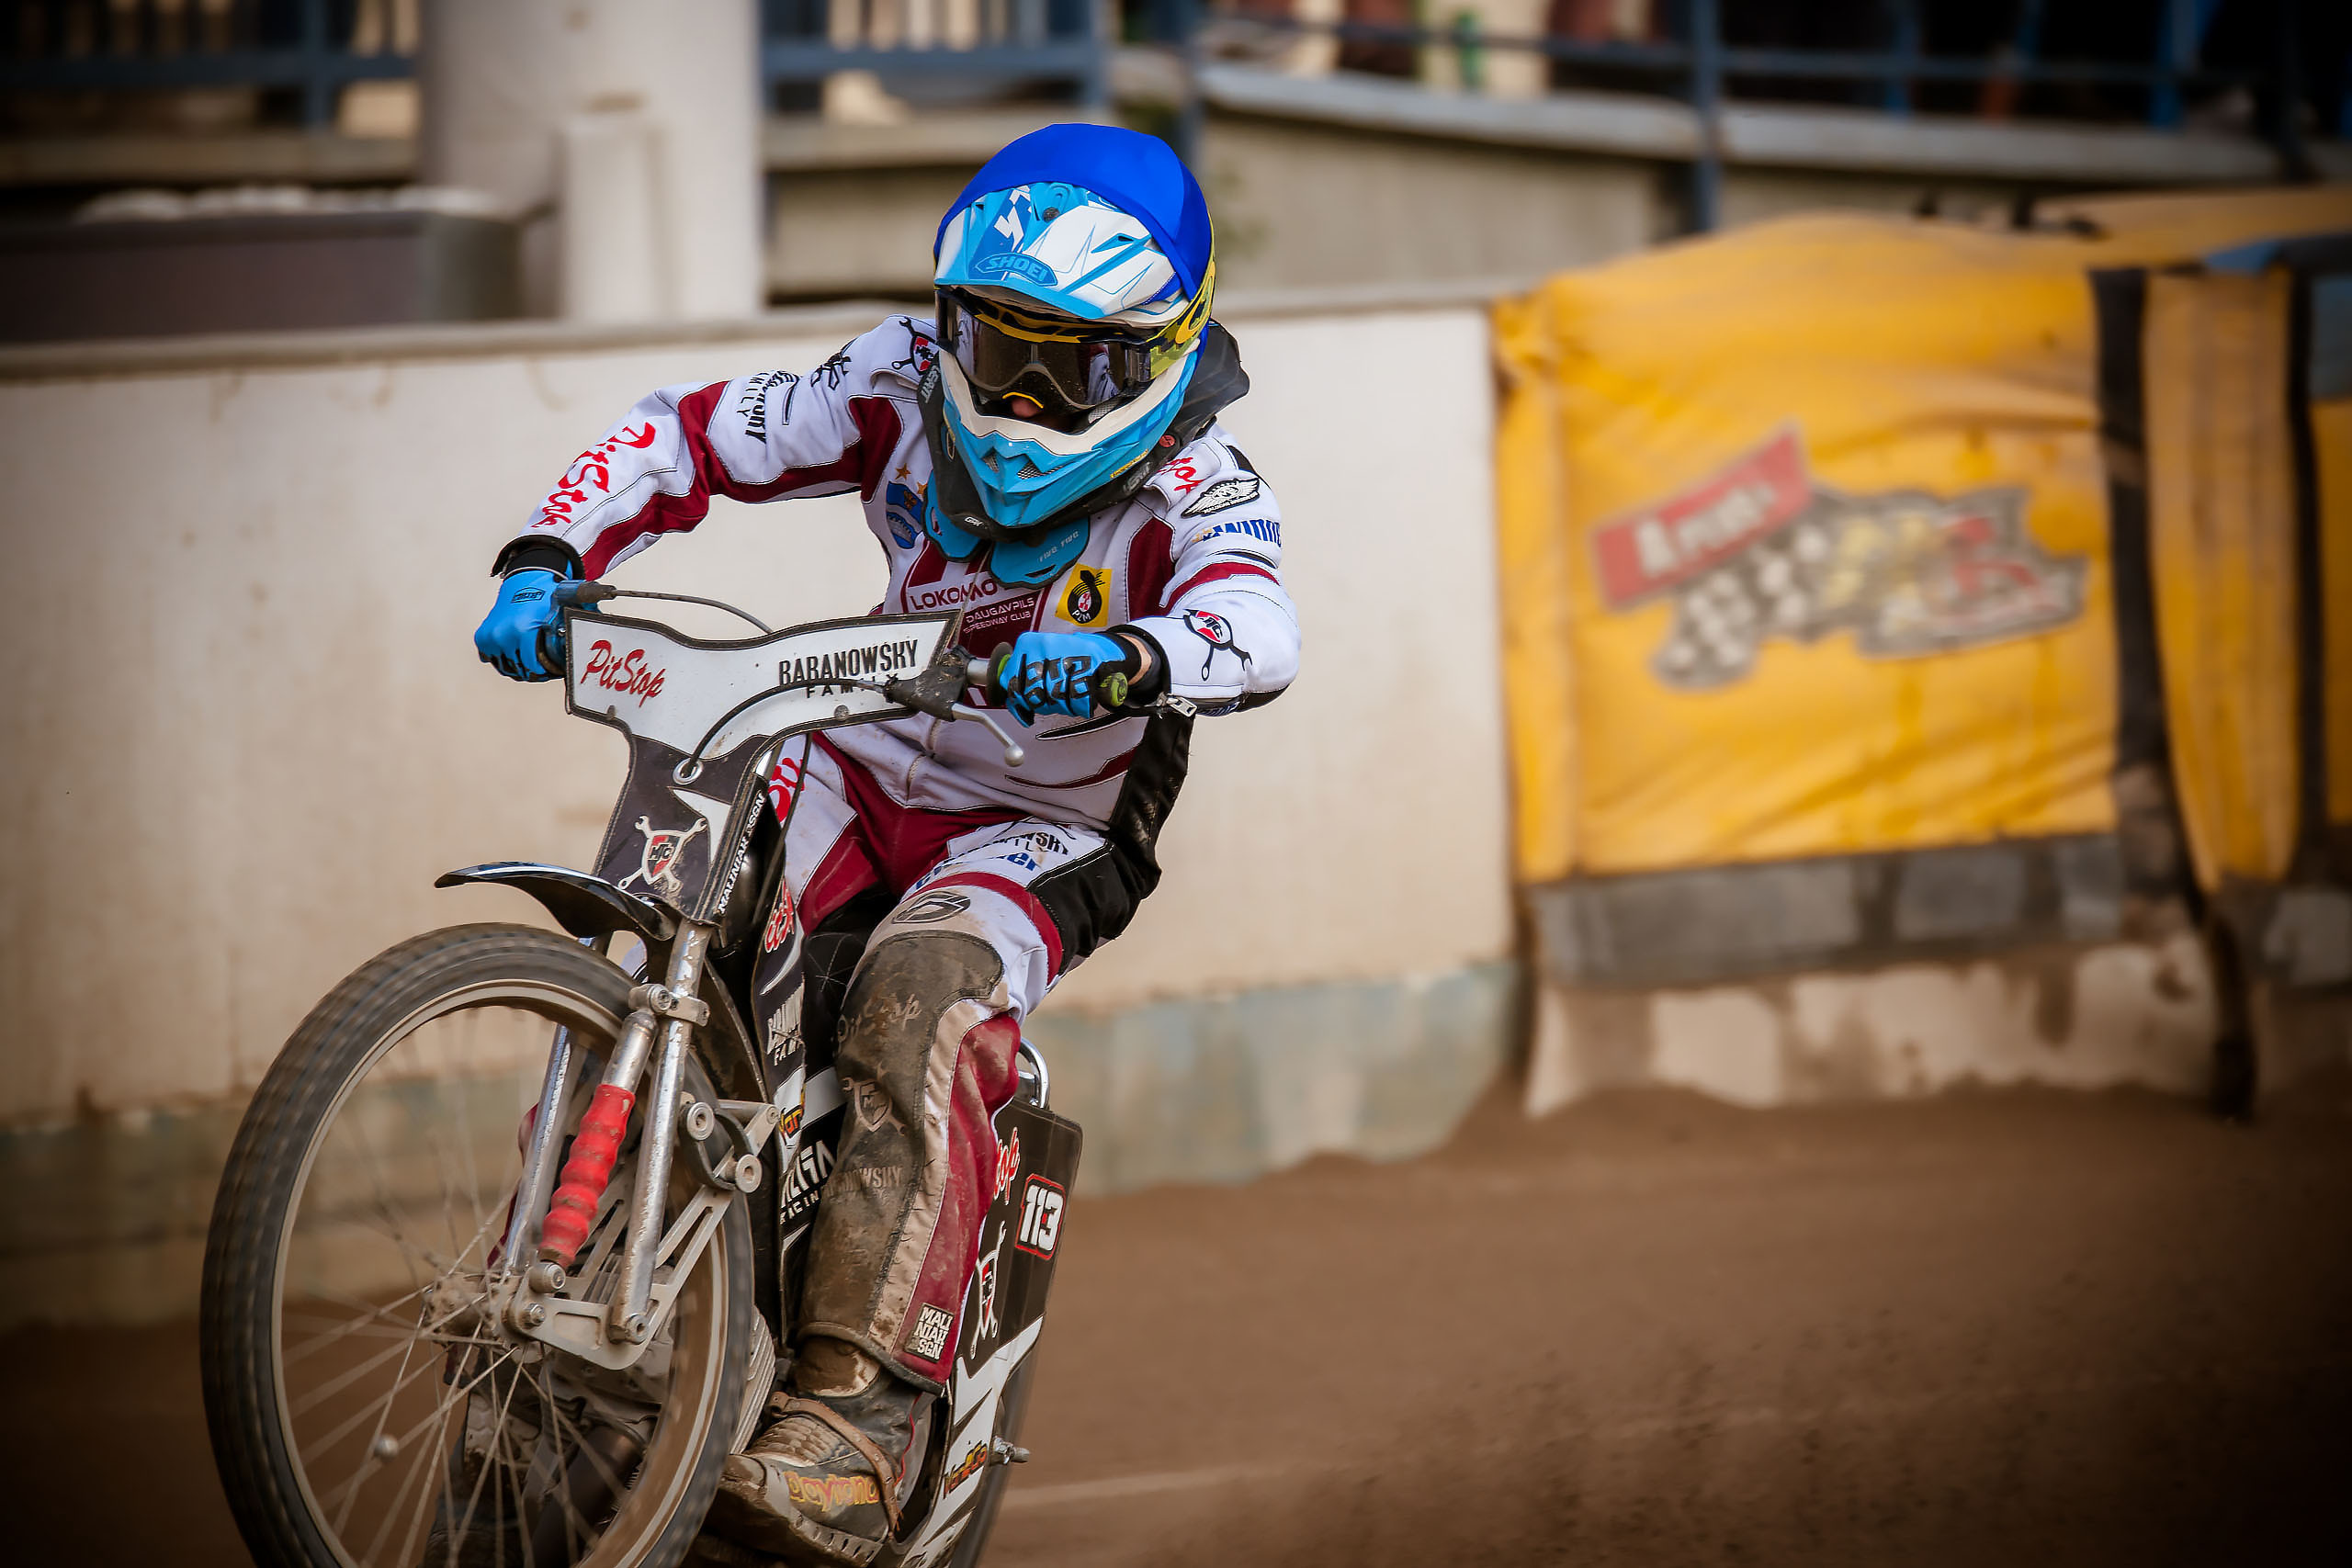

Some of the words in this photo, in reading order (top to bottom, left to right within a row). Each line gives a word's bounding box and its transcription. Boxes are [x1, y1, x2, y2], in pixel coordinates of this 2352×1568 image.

[985, 256, 1048, 282] SHOEI
[910, 578, 1003, 611] LOKOMO
[962, 615, 1009, 635] SPEEDWAY
[1010, 610, 1032, 622] CLUB
[965, 597, 1035, 624] DAUGAVPILS
[580, 639, 667, 708] PitStop
[1020, 1184, 1065, 1252] 113
[919, 1306, 954, 1331] MALI
